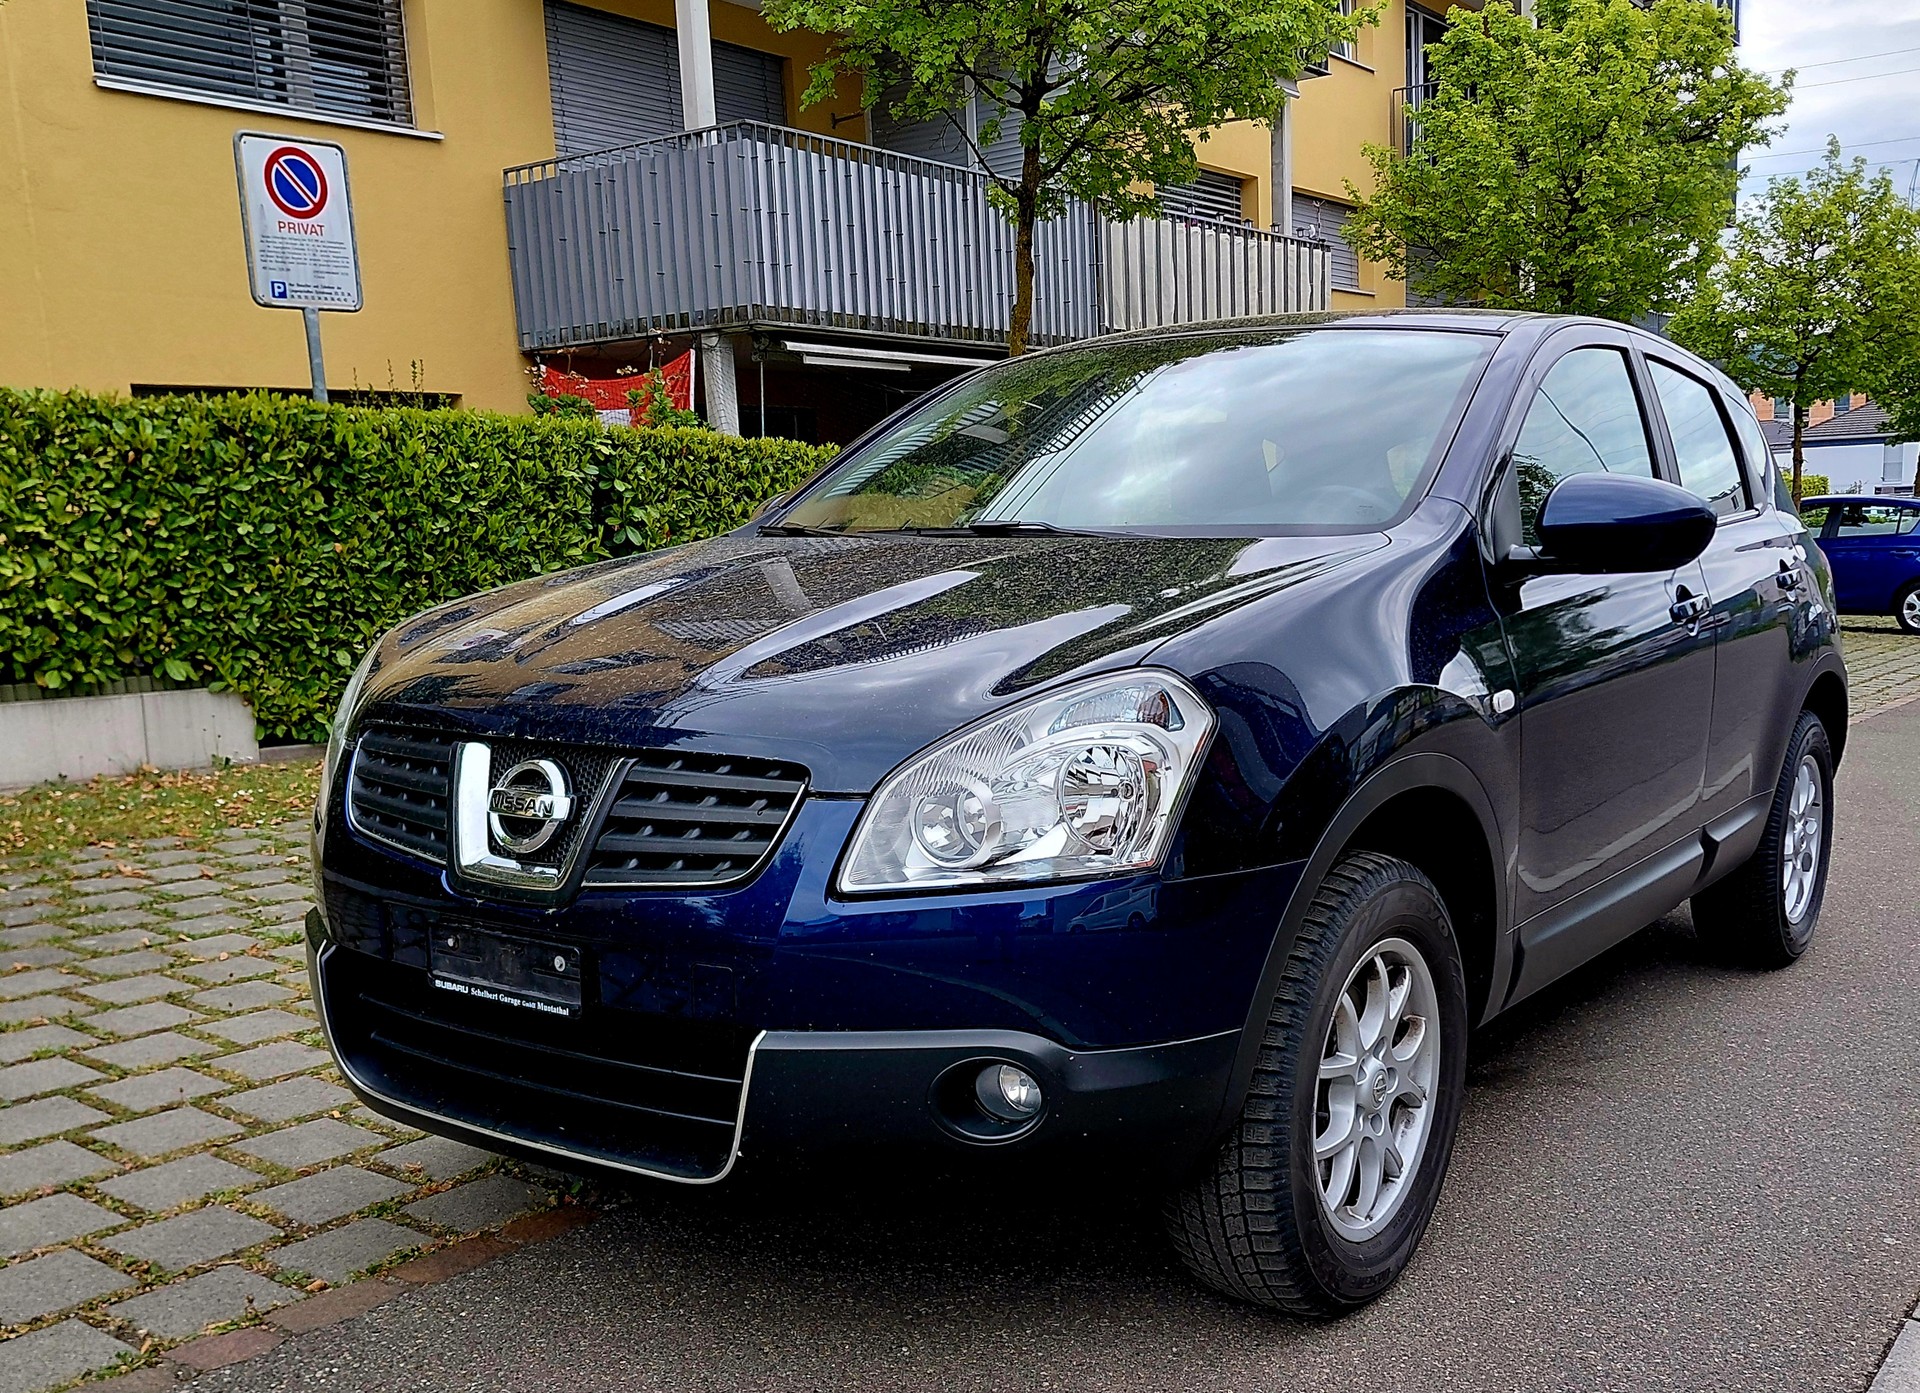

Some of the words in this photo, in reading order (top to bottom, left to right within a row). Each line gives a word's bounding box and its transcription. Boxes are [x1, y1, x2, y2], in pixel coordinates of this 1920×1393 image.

[278, 221, 325, 236] PRIVAT
[491, 791, 554, 816] NISSAN
[434, 979, 469, 994] SUBARU
[498, 993, 521, 1007] Garage
